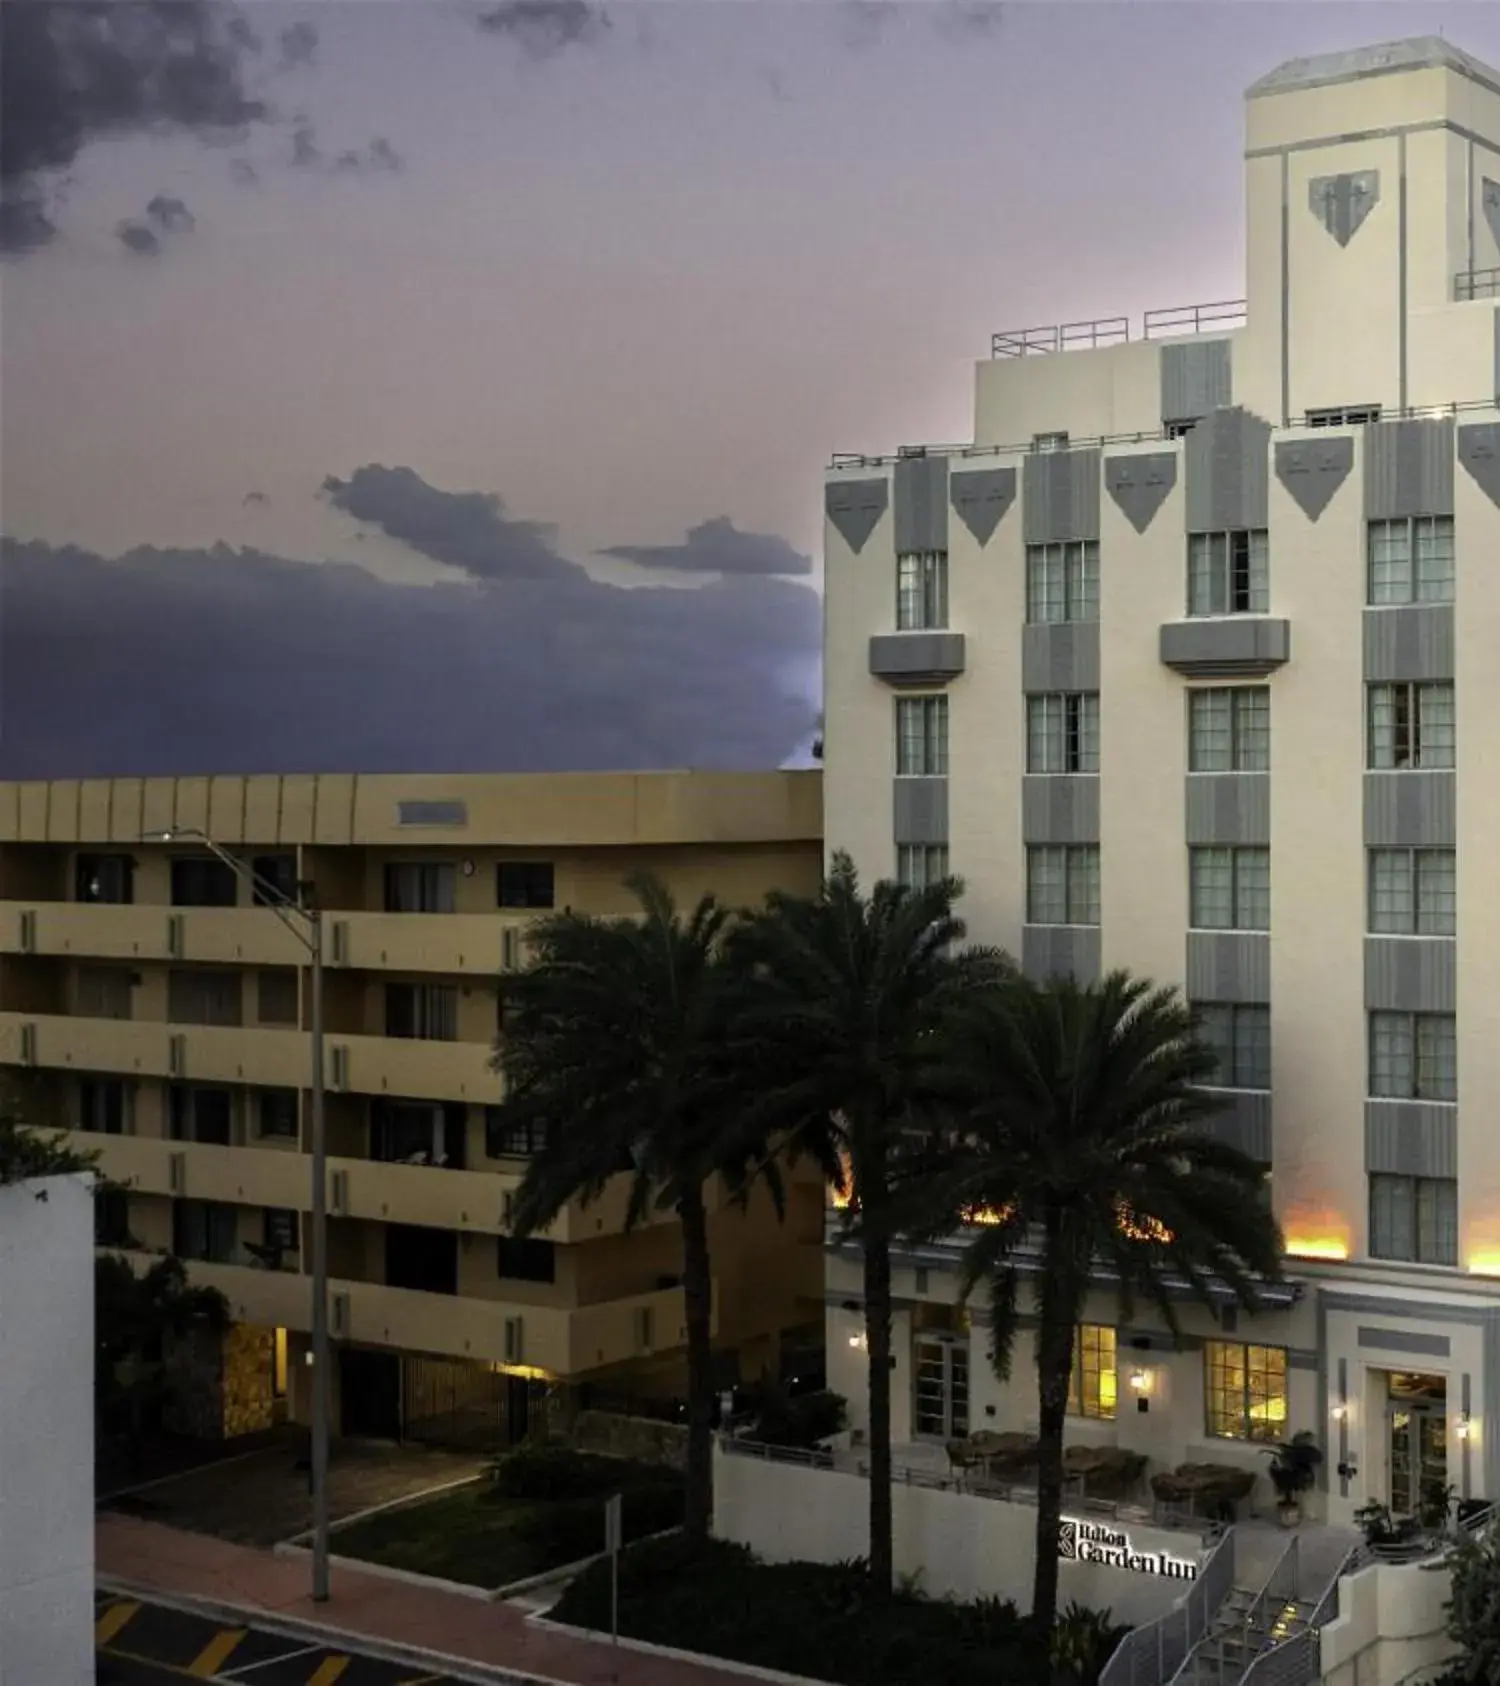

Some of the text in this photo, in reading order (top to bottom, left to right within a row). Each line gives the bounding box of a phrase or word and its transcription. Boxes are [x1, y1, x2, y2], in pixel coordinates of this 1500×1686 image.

[1079, 1524, 1126, 1547] Hilton
[1078, 1541, 1197, 1581] Garden Inn
